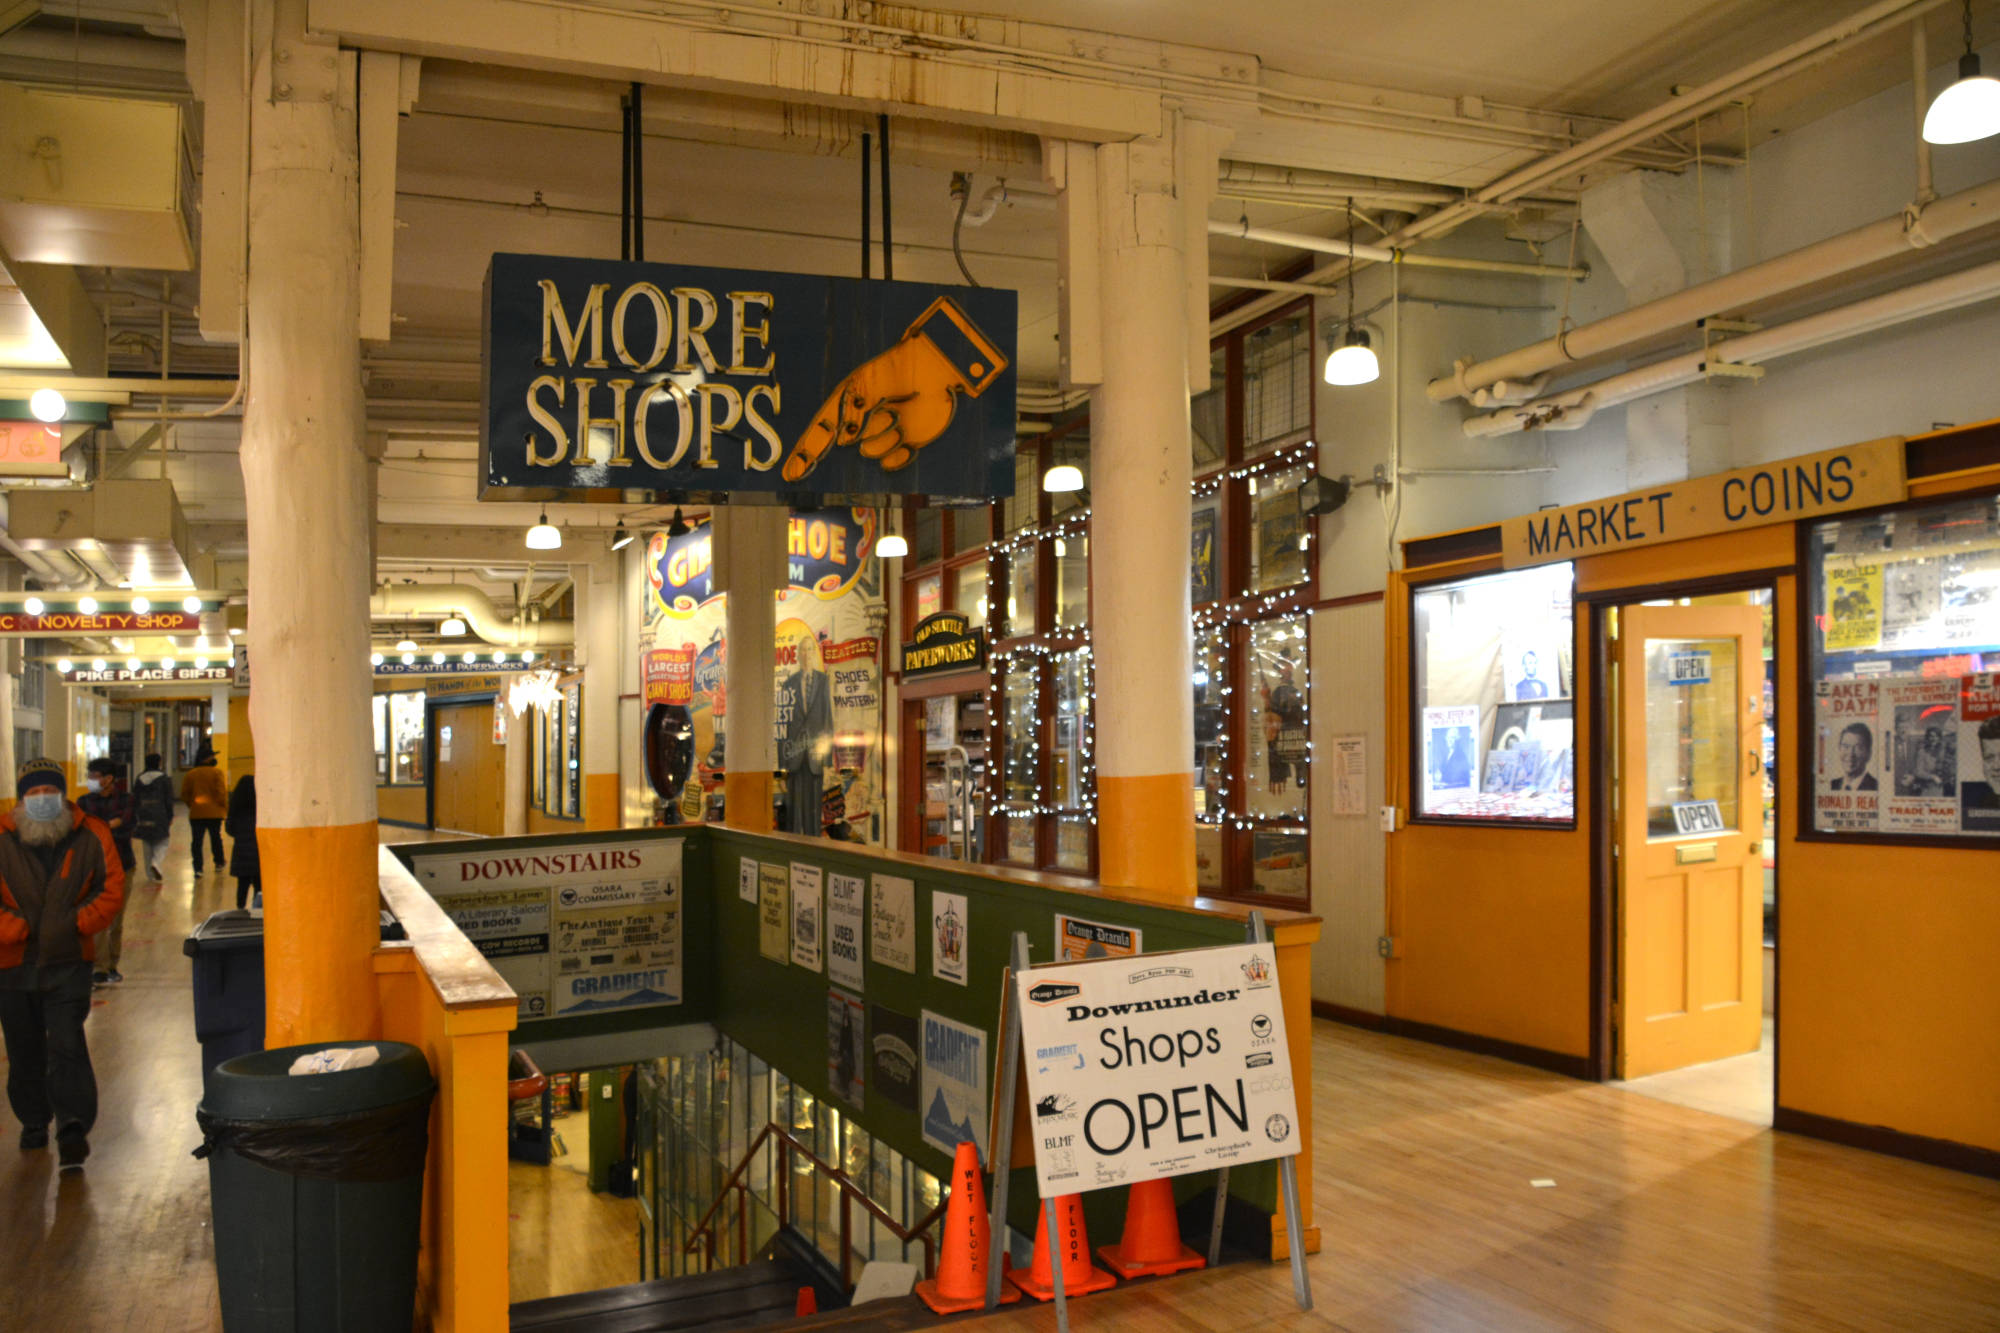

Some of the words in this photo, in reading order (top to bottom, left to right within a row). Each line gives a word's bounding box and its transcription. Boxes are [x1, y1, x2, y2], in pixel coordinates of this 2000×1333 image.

[537, 279, 776, 376] MORE
[526, 374, 782, 472] SHOPS
[1528, 492, 1672, 556] MARKET
[1722, 455, 1854, 522] COINS
[38, 614, 132, 630] NOVELTY
[136, 614, 184, 629] SHOP
[916, 625, 931, 644] OLD
[931, 619, 964, 636] SEATTLE
[825, 640, 876, 660] SEATTLE'S
[905, 638, 976, 671] PAPERWORKS
[76, 670, 114, 682] PIKE
[118, 669, 173, 681] PLACE
[179, 668, 227, 679] GIFTS
[380, 663, 404, 673] OLD
[407, 663, 452, 673] SEATTLE
[456, 661, 523, 672] PAPERWORKS
[648, 662, 691, 673] LARGEST
[834, 670, 870, 684] SHOES
[1675, 658, 1705, 680] OPEN
[648, 681, 669, 699] GIANT
[669, 681, 691, 699] SHOES
[845, 685, 860, 693] OF
[833, 694, 876, 708] MYSTERY
[1679, 804, 1722, 831] OPEN
[1888, 806, 1924, 817] TRADE
[460, 850, 642, 882] DOWNSTAIRS
[578, 892, 636, 904] COMMISSARY
[592, 884, 622, 894] OSARA
[482, 917, 521, 929] BOOKS
[559, 920, 578, 930] The
[834, 924, 854, 943] USED
[1067, 921, 1093, 939] Orange
[1096, 927, 1130, 947] Dracula
[832, 940, 858, 962] BOOKS
[572, 969, 668, 996] GRADIENT
[1066, 988, 1241, 1022] Downunder
[1100, 1026, 1222, 1070] Shops
[1083, 1078, 1250, 1156] OPEN
[1044, 1134, 1076, 1150] BLMF
[963, 1169, 975, 1204] WET
[1068, 1204, 1080, 1263] FLOOR
